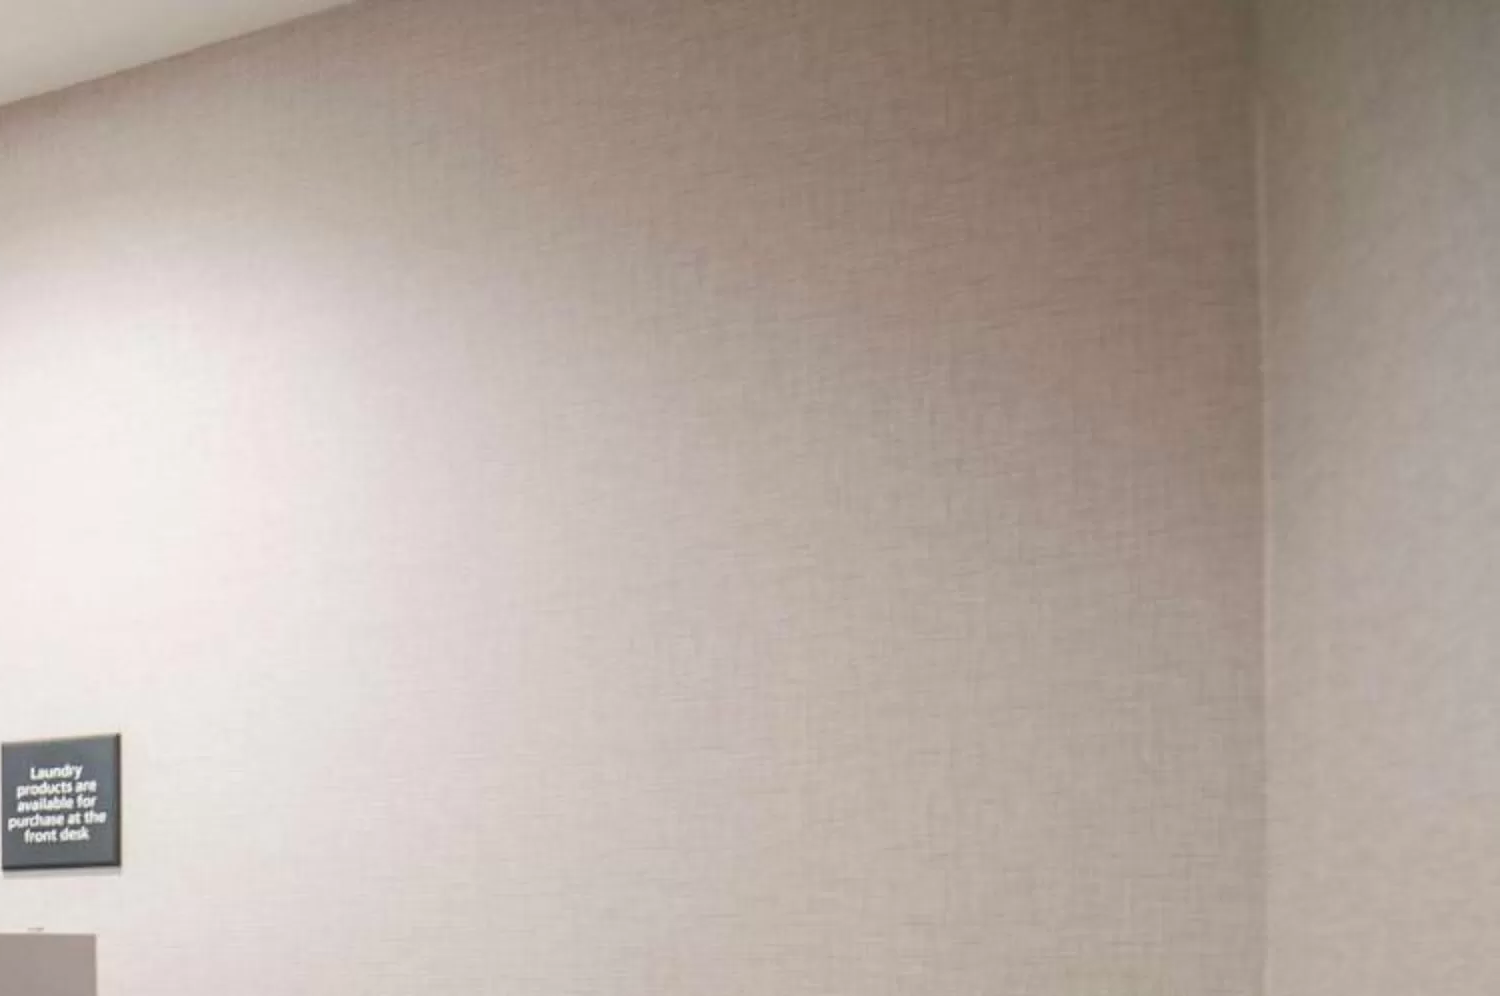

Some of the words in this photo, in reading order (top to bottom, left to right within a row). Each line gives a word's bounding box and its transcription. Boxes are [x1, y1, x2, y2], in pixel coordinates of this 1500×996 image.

[29, 764, 84, 781] Laundry
[16, 782, 73, 800] products
[75, 779, 97, 793] are
[16, 795, 75, 813] available
[76, 793, 98, 809] for
[7, 813, 65, 832] purchase
[67, 812, 82, 825] at
[83, 809, 107, 824] the
[24, 828, 57, 844] front
[59, 825, 90, 842] desk
